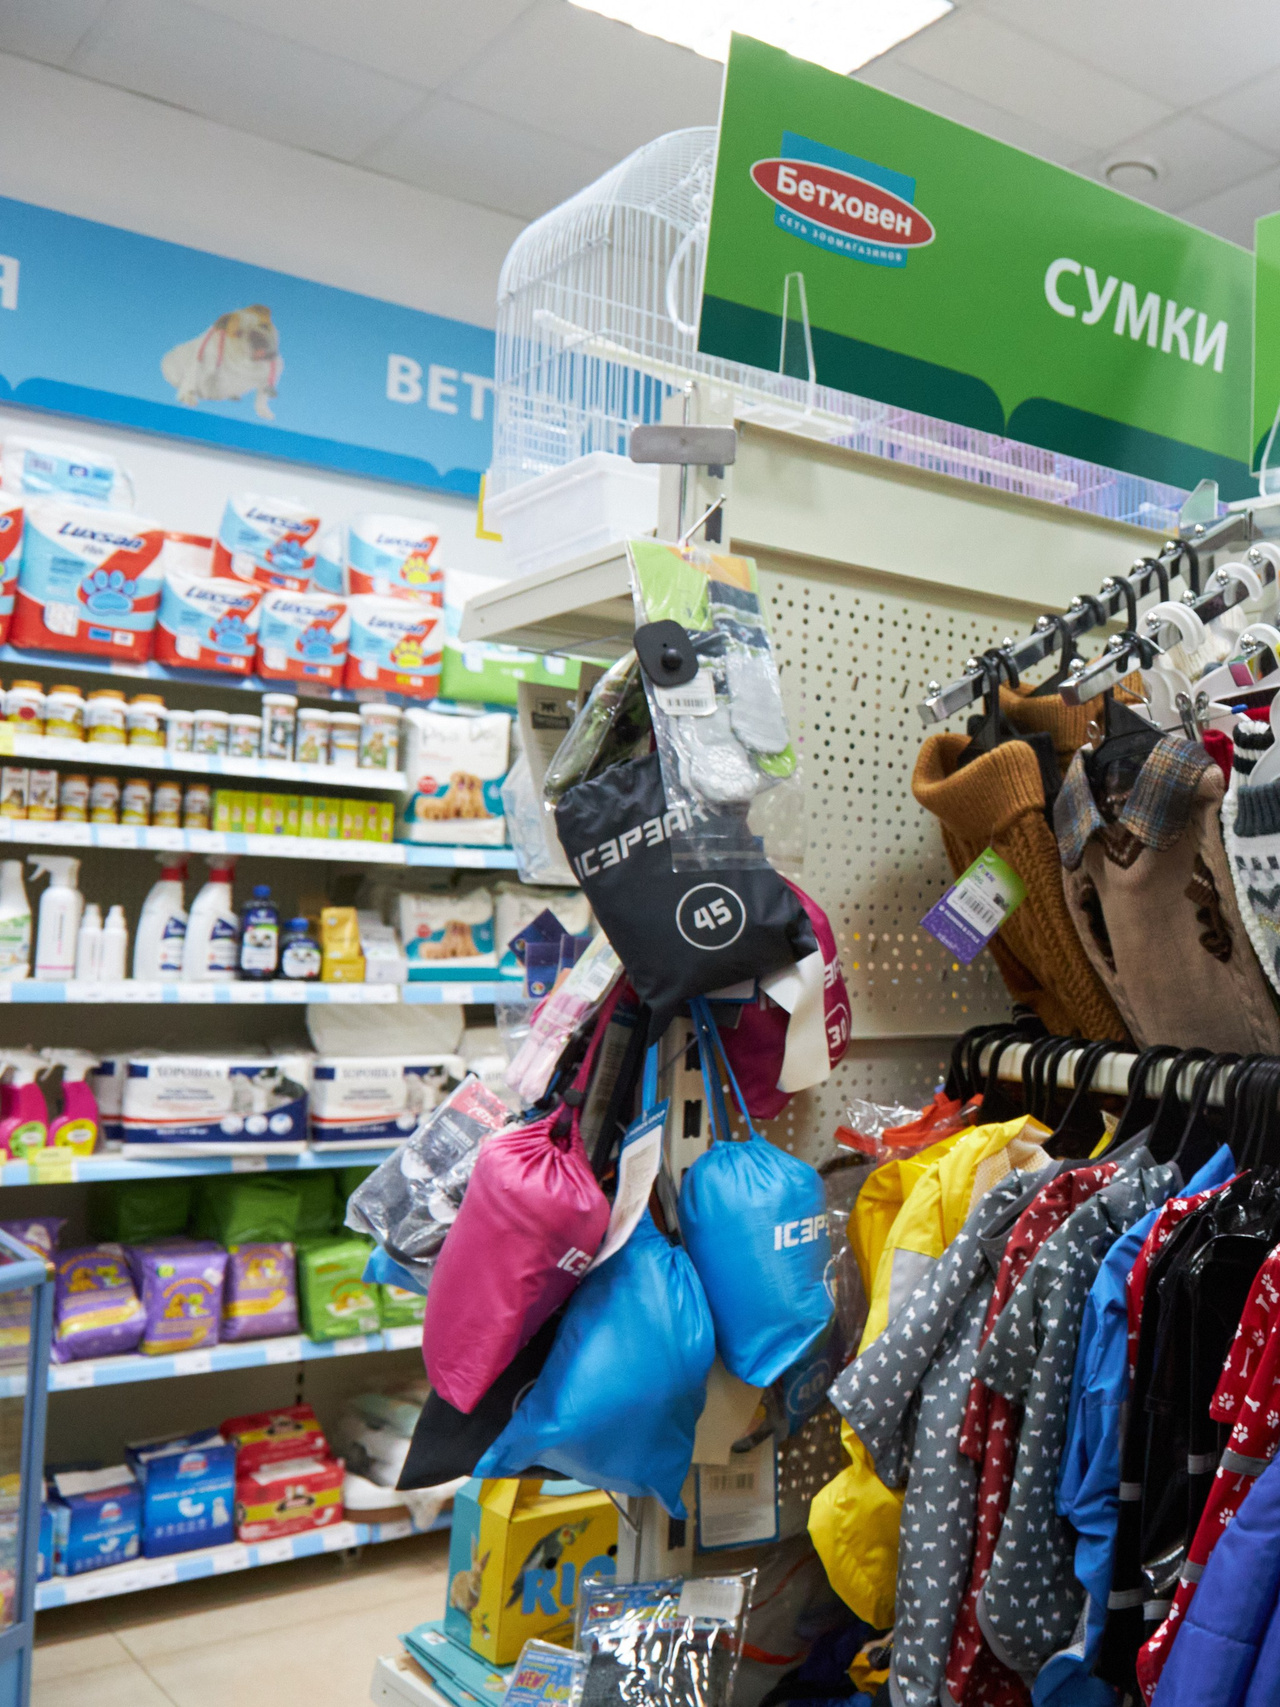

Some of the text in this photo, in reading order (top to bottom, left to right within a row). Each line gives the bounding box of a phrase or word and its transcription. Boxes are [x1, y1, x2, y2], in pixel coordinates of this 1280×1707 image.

[775, 164, 912, 237] Бетховен
[779, 212, 904, 264] СЕТЬ ЗООМАГАЗИНОВ
[1044, 256, 1228, 373] СУМКИ
[59, 521, 144, 549] Luxsan
[186, 586, 252, 608] Luxsan
[272, 599, 337, 619] Luxsan
[368, 616, 426, 634] Luxsan
[692, 898, 733, 932] 45
[515, 1669, 548, 1690] NEW!
